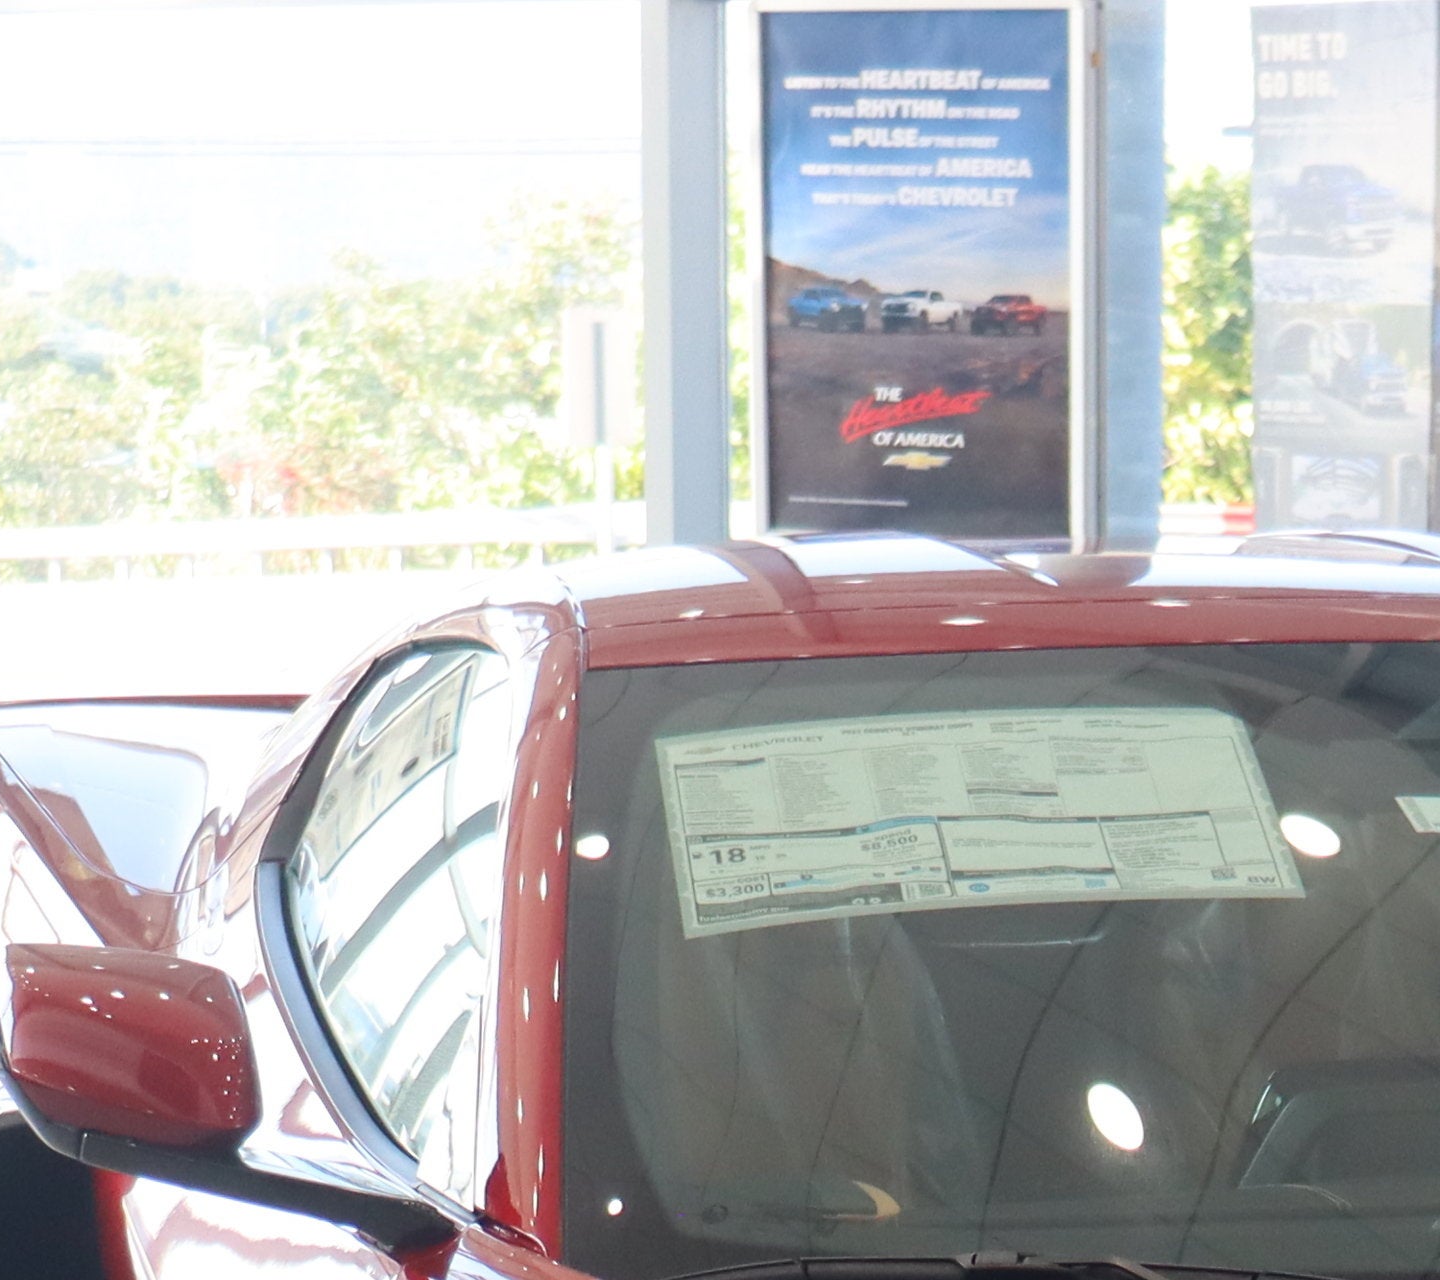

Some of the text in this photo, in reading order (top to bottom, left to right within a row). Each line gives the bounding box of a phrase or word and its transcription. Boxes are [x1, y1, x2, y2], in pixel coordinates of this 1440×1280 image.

[1258, 32, 1348, 61] TIME TO
[861, 70, 982, 90] HEARTBEAT
[1257, 70, 1289, 98] GO
[856, 99, 947, 119] RHYTHM
[852, 128, 919, 148] PULSE
[935, 157, 1032, 179] AMERICA
[897, 187, 1019, 208] CHEVROLET
[873, 385, 903, 403] THE
[872, 430, 965, 449] OF AMERICA
[731, 734, 824, 751] CHEVROLET
[709, 847, 747, 865] 18
[706, 883, 764, 899] $3,300
